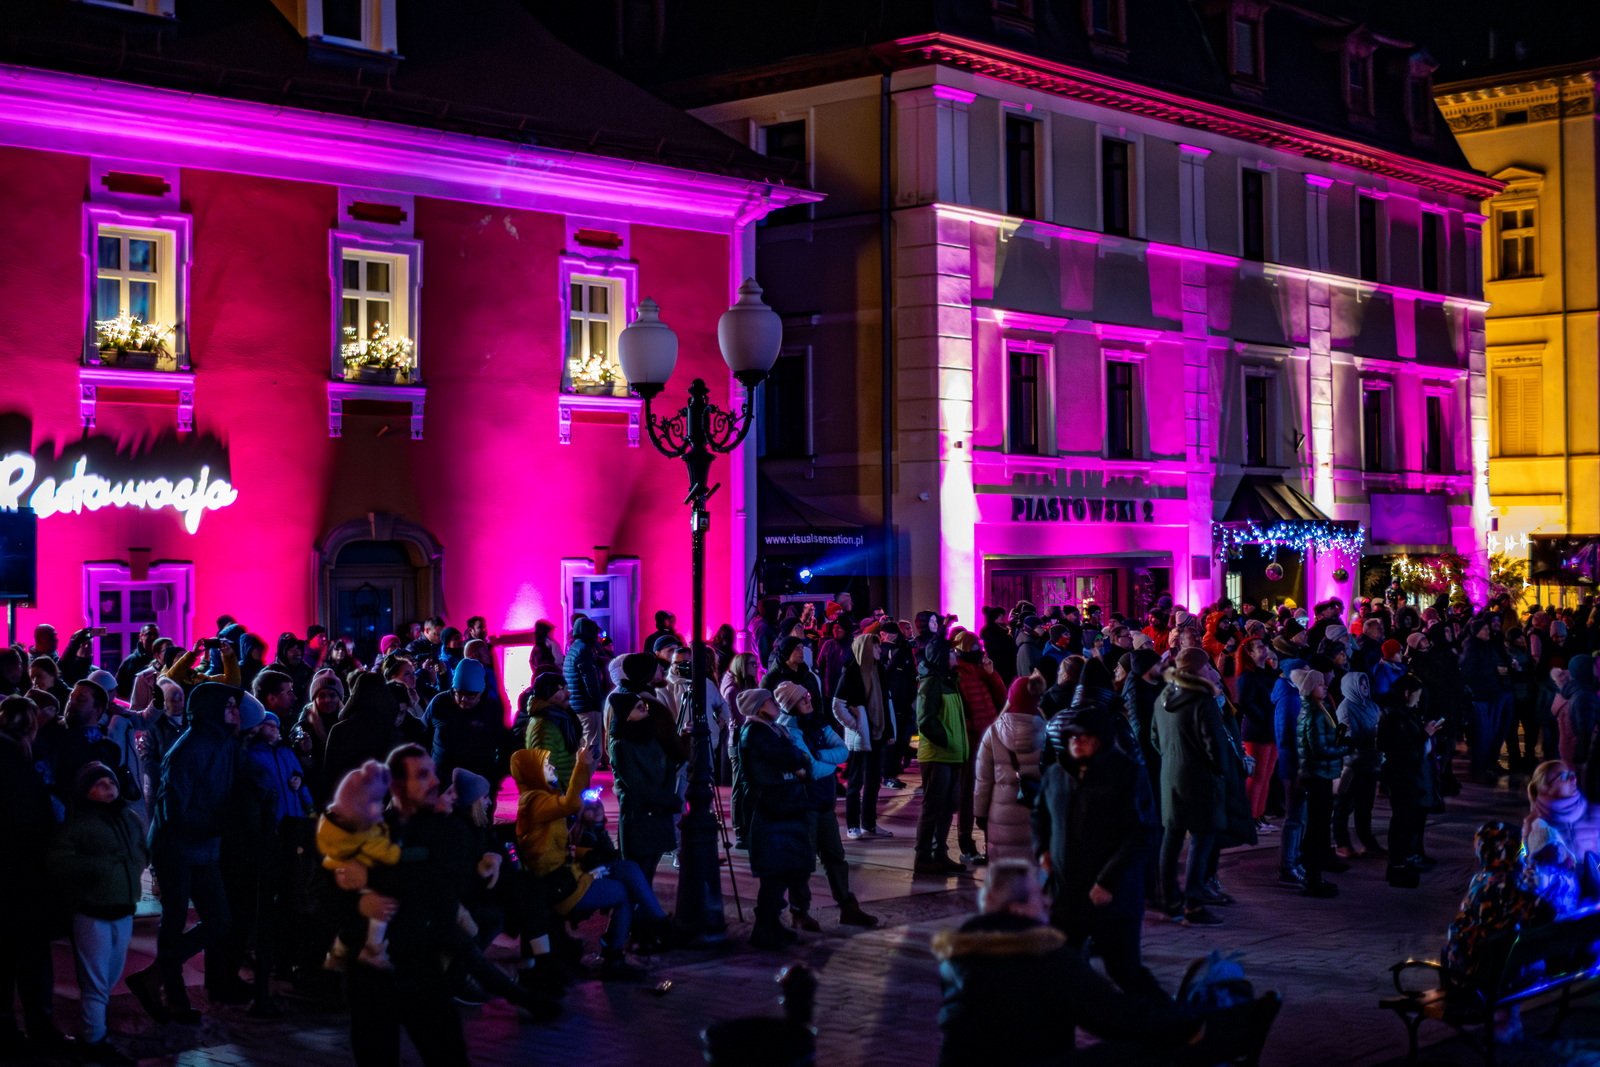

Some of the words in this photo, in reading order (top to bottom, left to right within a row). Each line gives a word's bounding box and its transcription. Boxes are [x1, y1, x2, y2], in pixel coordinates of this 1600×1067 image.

[1011, 497, 1137, 522] PIASTOWSKI
[1142, 500, 1154, 522] 2
[765, 534, 863, 546] www.visualsensation.pl
